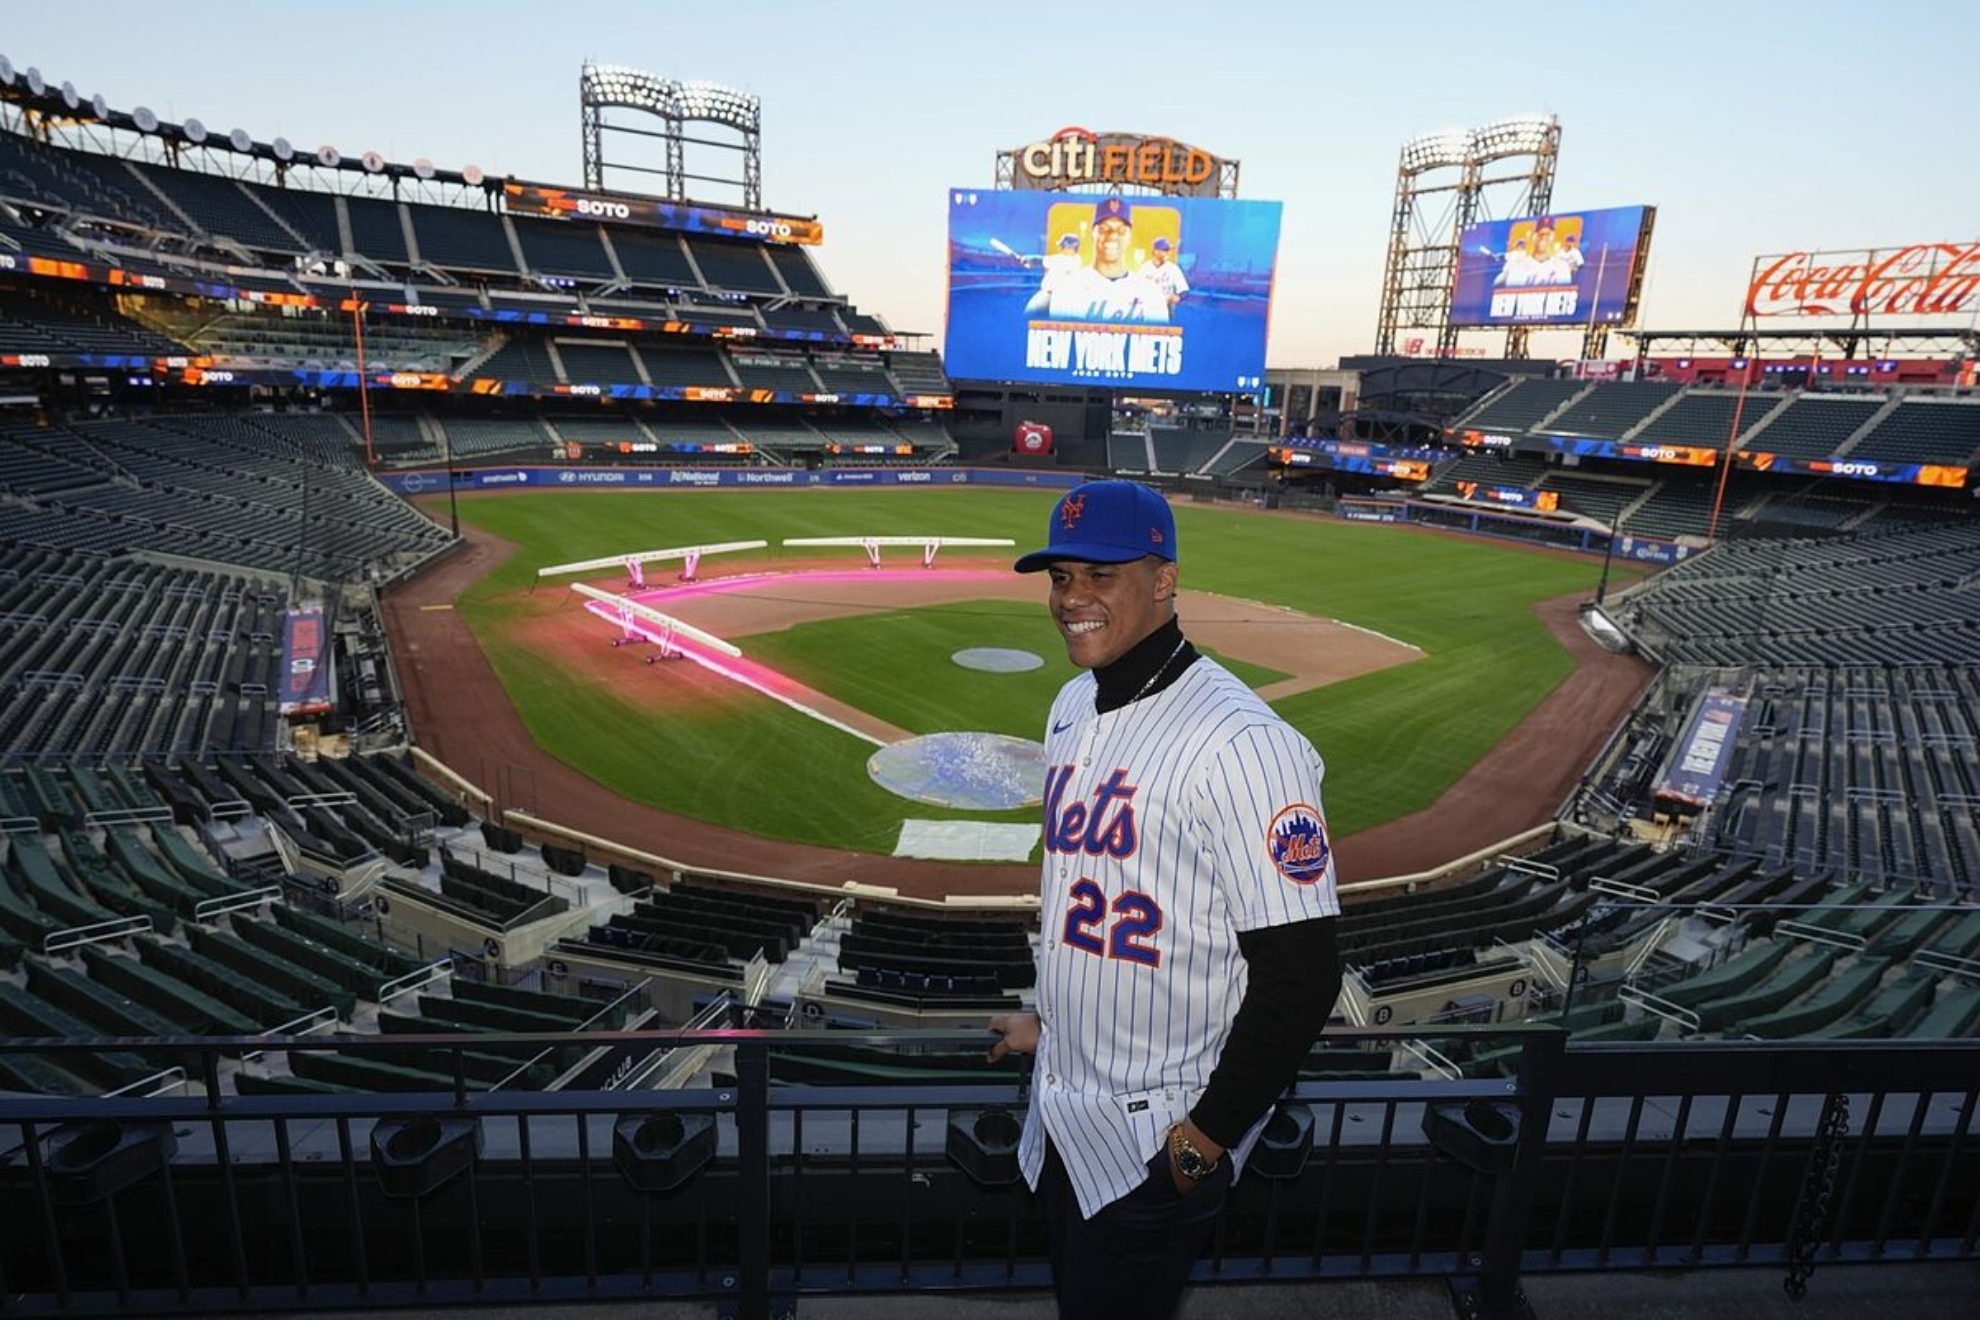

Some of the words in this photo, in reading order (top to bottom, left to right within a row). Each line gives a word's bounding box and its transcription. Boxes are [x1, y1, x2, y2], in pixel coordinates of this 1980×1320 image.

[1023, 135, 1095, 178] citi
[1103, 145, 1213, 183] FIELD
[576, 199, 630, 218] SOTO
[745, 219, 792, 237] SOTO
[405, 304, 438, 316] SOTO
[581, 316, 610, 327] SOTO
[732, 326, 756, 337] SOTO
[1026, 329, 1073, 369] NEW
[1075, 331, 1128, 371] YORK
[1128, 334, 1183, 375] METS
[17, 354, 50, 367] SOTO
[202, 371, 234, 382] SOTO
[569, 384, 601, 396] SOTO
[699, 387, 728, 399] SOTO
[814, 393, 839, 404] SOTO
[1483, 434, 1512, 446] SOTO
[632, 442, 657, 452] SOTO
[1640, 447, 1676, 460] SOTO
[1832, 462, 1877, 476] SOTO
[579, 472, 625, 482] HYUNDAI
[746, 473, 794, 483] Northwell
[897, 471, 931, 481] verizon
[1499, 491, 1524, 502] SOTO
[1281, 832, 1322, 862] Mets
[1063, 877, 1163, 969] 22
